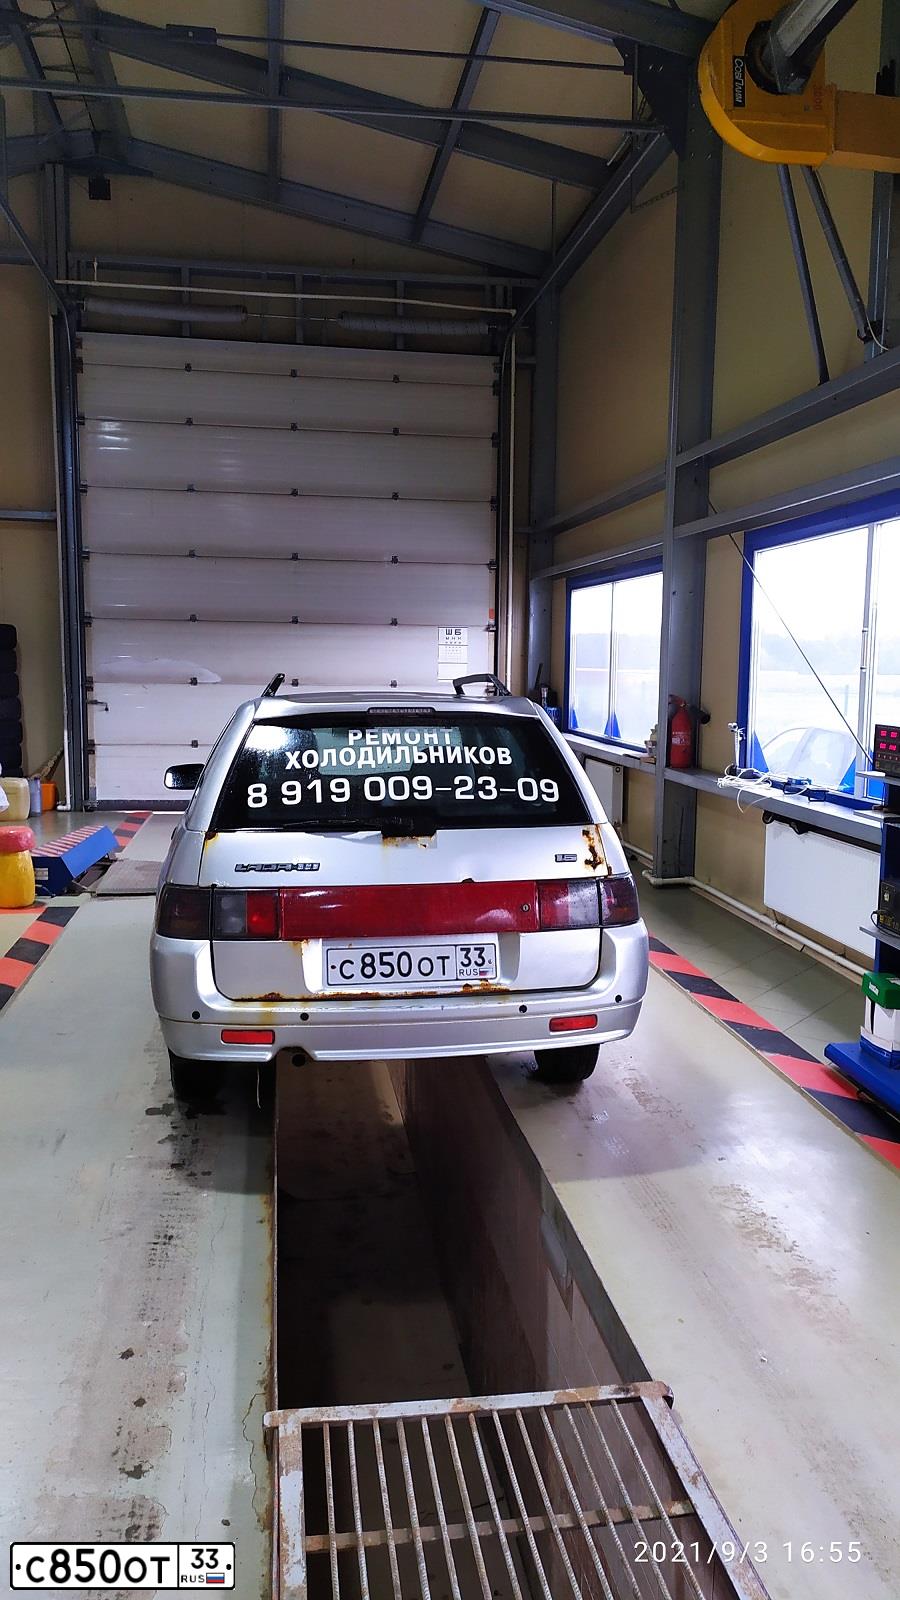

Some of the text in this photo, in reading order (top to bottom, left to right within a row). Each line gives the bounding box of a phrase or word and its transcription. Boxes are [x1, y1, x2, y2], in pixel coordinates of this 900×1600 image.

[348, 729, 453, 746] РЕМОНТ
[285, 746, 513, 769] ХОЛОДИЛЬНИКОВ
[247, 775, 560, 808] 8 919 009-23-09
[460, 947, 486, 967] 33
[458, 968, 479, 976] RUS
